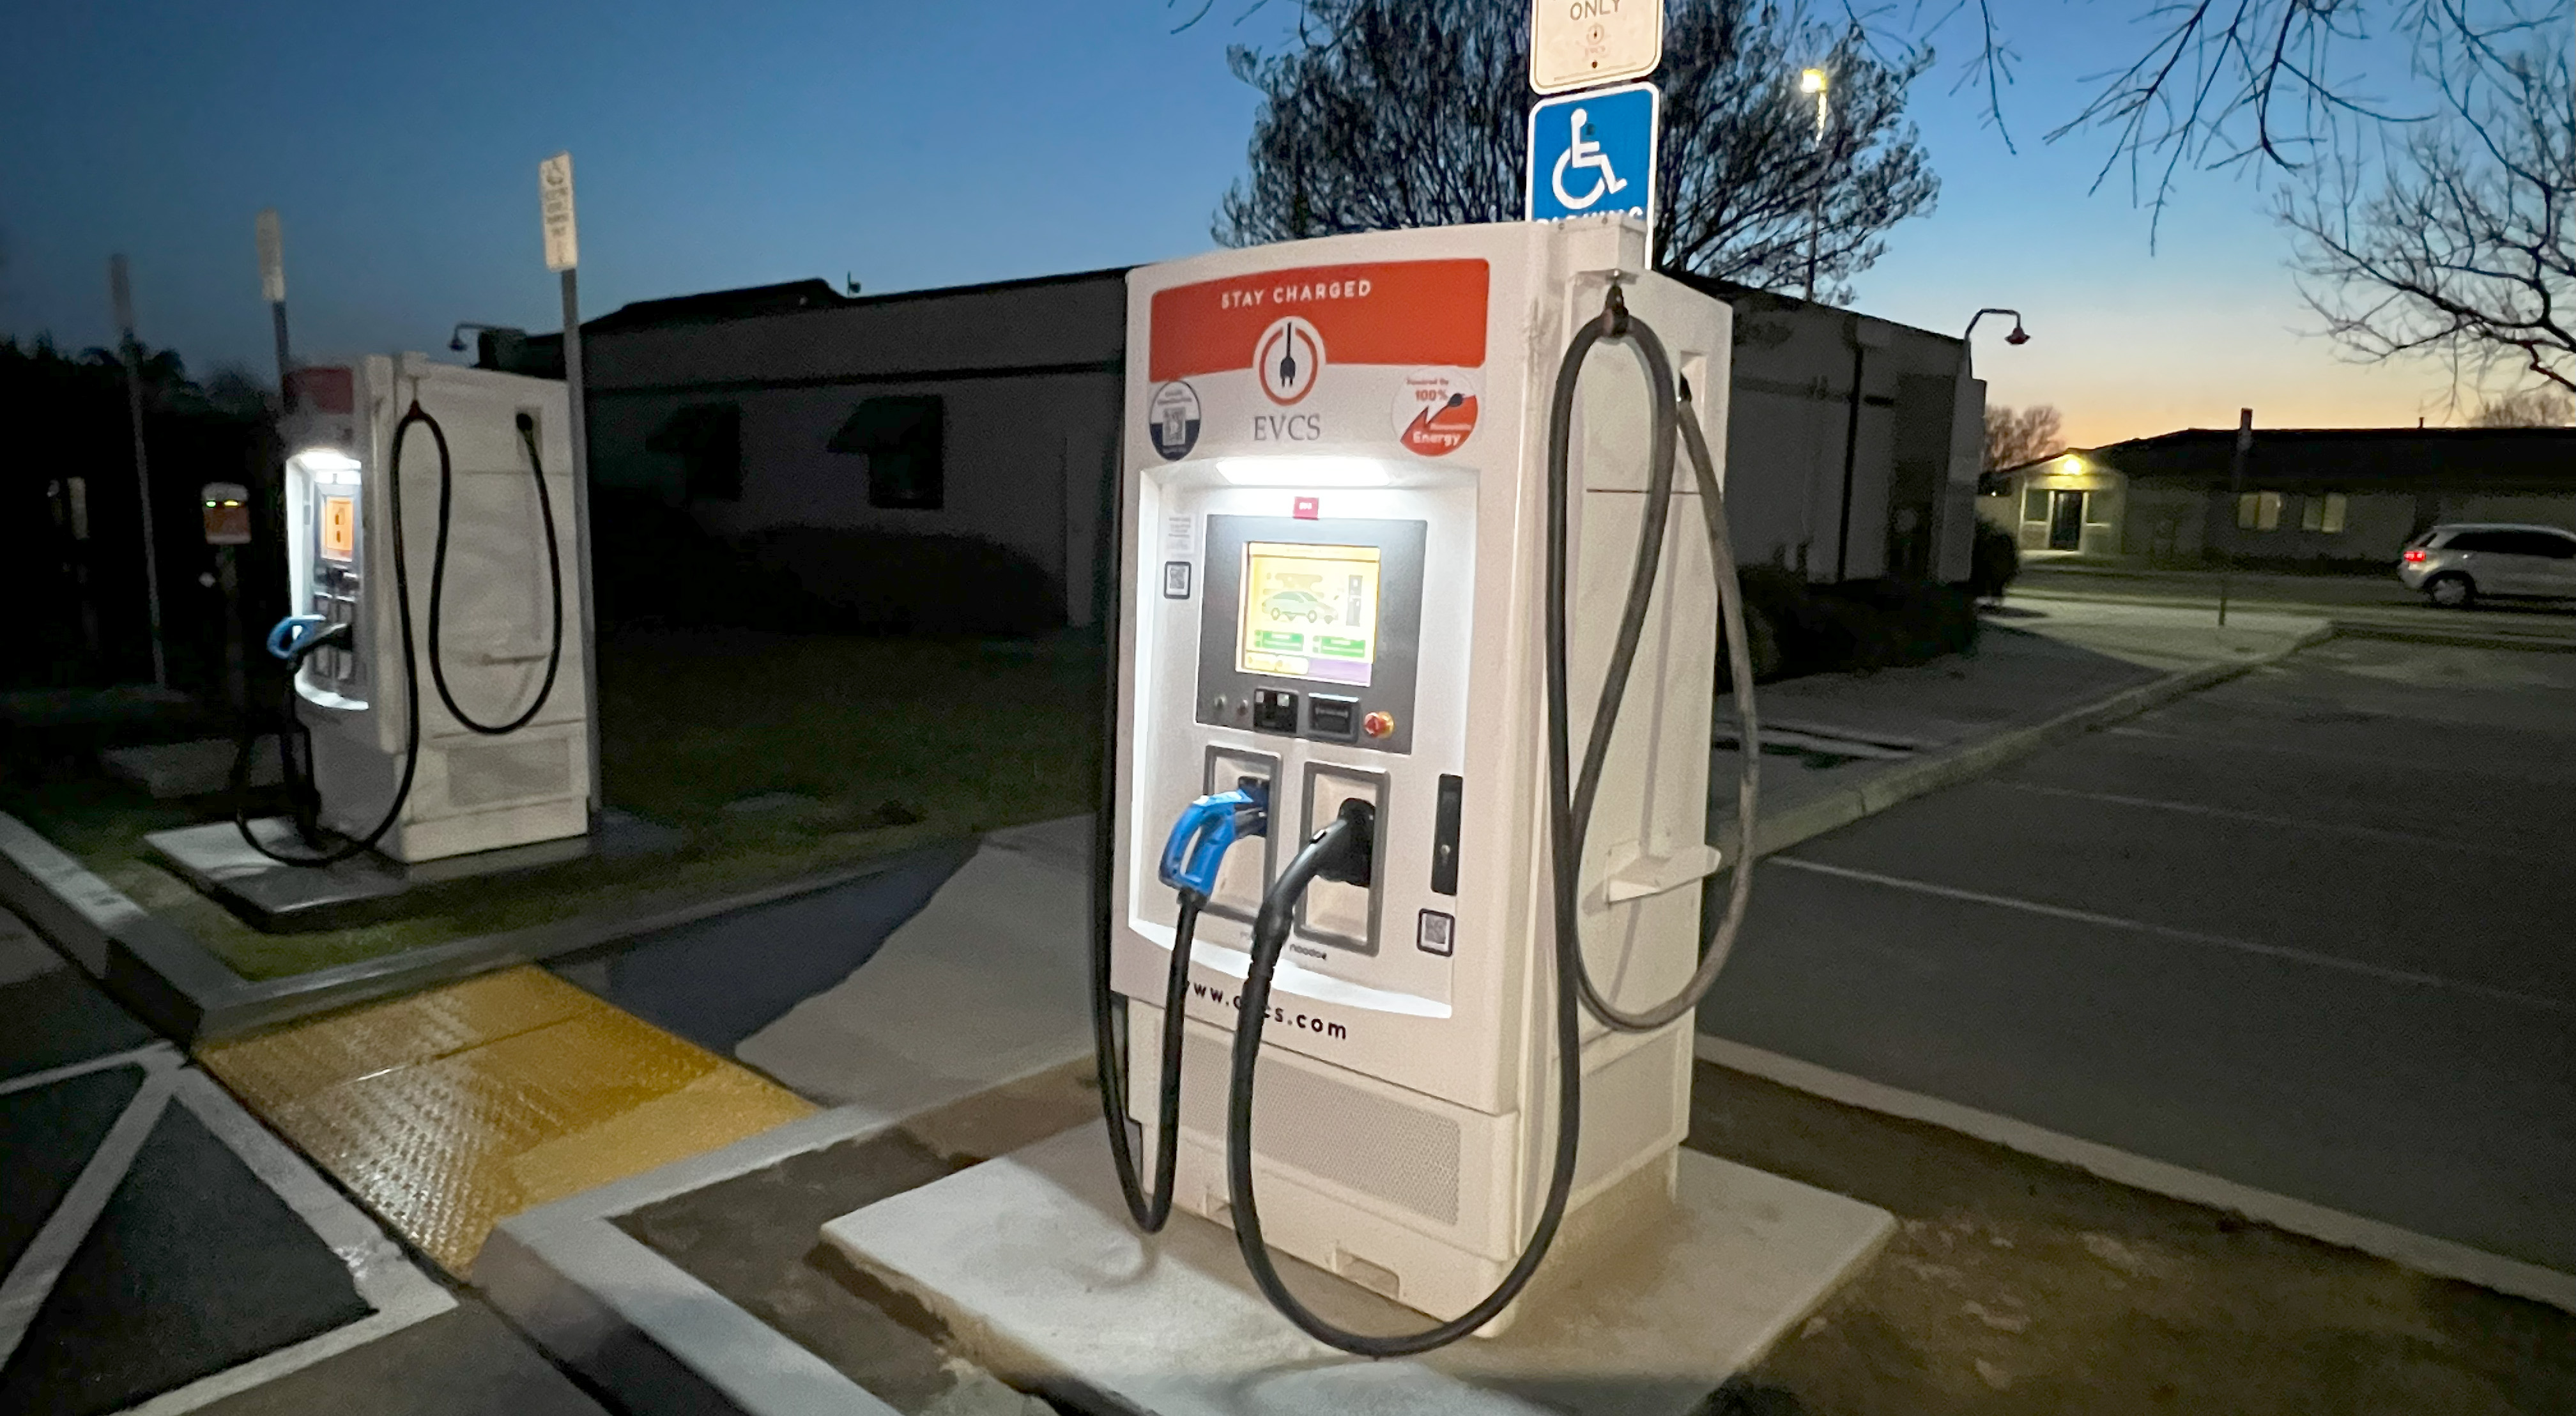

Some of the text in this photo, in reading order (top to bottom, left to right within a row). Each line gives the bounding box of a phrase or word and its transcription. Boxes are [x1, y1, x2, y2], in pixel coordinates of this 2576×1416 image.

[1570, 0, 1620, 20] ONLY
[1222, 280, 1371, 309] STAY CHARGED
[1254, 413, 1321, 441] EVCS
